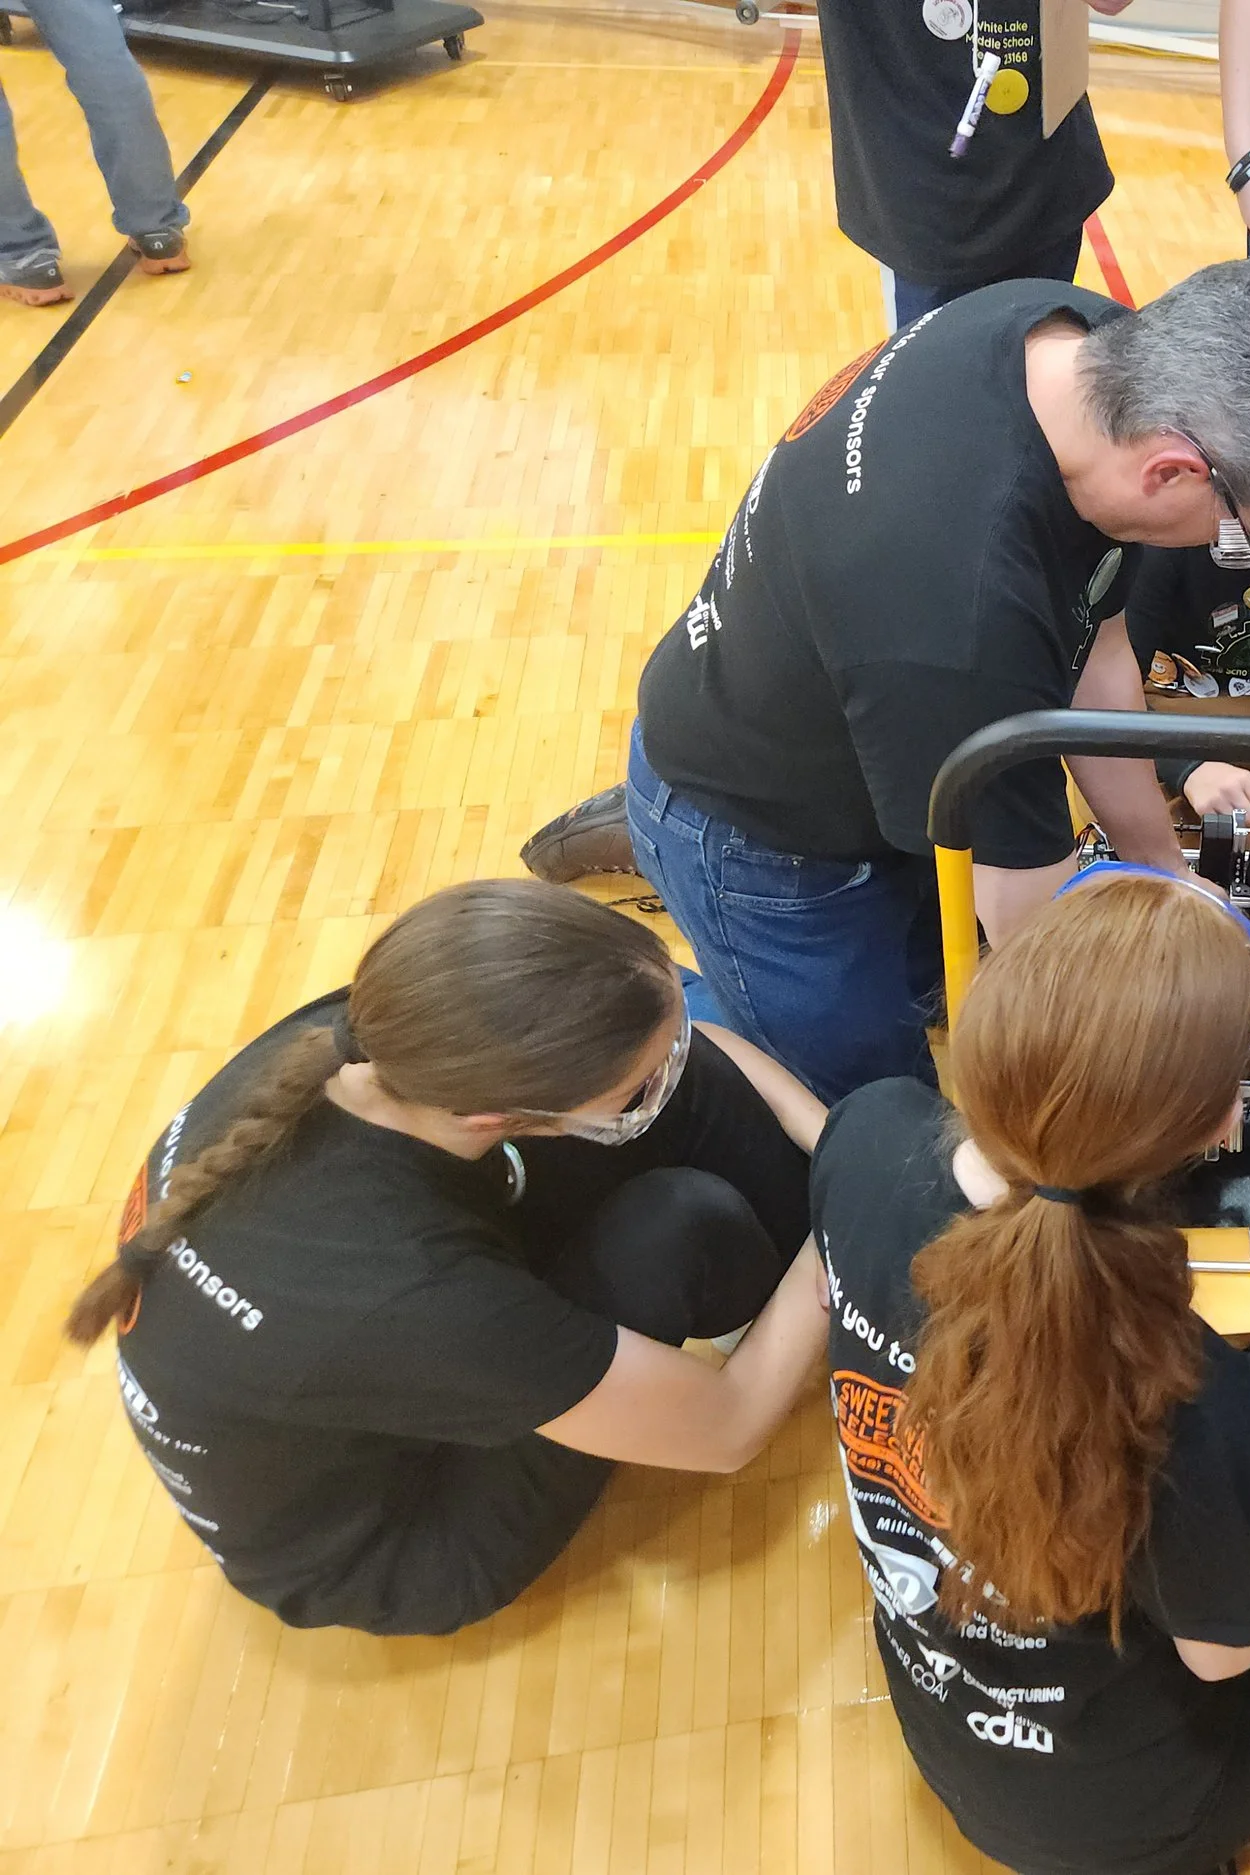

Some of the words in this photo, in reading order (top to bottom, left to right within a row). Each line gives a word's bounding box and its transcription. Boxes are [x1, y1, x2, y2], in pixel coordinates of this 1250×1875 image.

[1004, 21, 1028, 32] Lake
[965, 34, 1001, 49] Mddle
[1002, 36, 1034, 49] School
[892, 332, 916, 351] to
[871, 352, 896, 381] our
[846, 385, 877, 495] sponsors
[167, 1236, 264, 1331] ponsors
[841, 1301, 885, 1351] you
[888, 1340, 917, 1374] to
